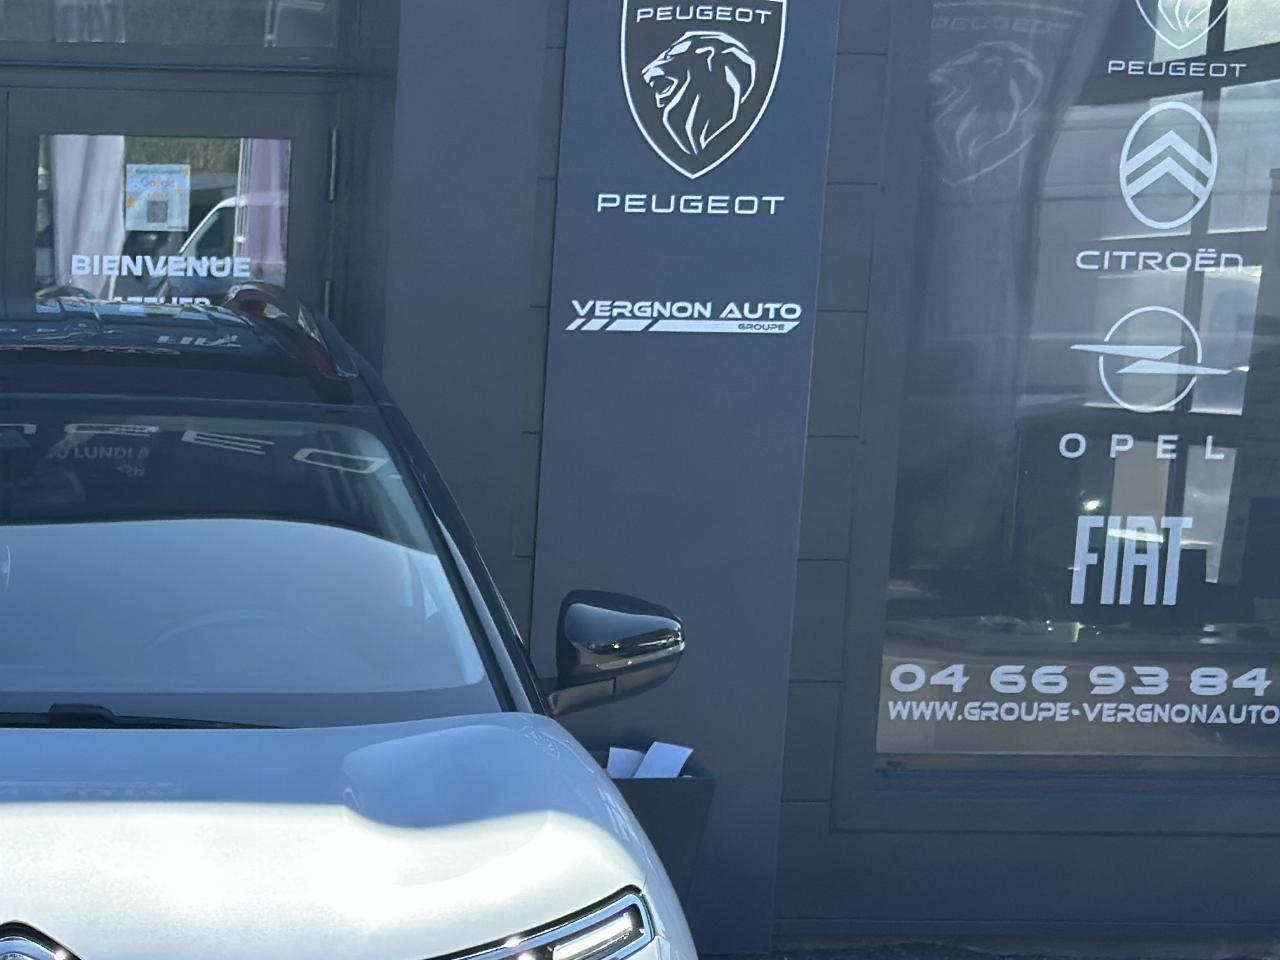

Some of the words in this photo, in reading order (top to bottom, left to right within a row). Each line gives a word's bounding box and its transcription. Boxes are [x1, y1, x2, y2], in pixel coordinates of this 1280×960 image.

[635, 6, 772, 25] PEUGEOT
[1107, 60, 1247, 78] PEUGEOT
[597, 193, 785, 215] PEUGEOT
[71, 254, 252, 278] BIENVENUE
[1075, 248, 1244, 273] CITROËN
[571, 300, 712, 319] VERGNON
[720, 302, 802, 319] AUTO
[737, 323, 785, 331] GROUPE
[1058, 432, 1225, 460] OPEL
[1070, 515, 1193, 606] FIAT
[889, 663, 970, 693] 04
[989, 664, 1069, 694] 66
[1089, 665, 1170, 695] 93
[1189, 667, 1272, 697] 84
